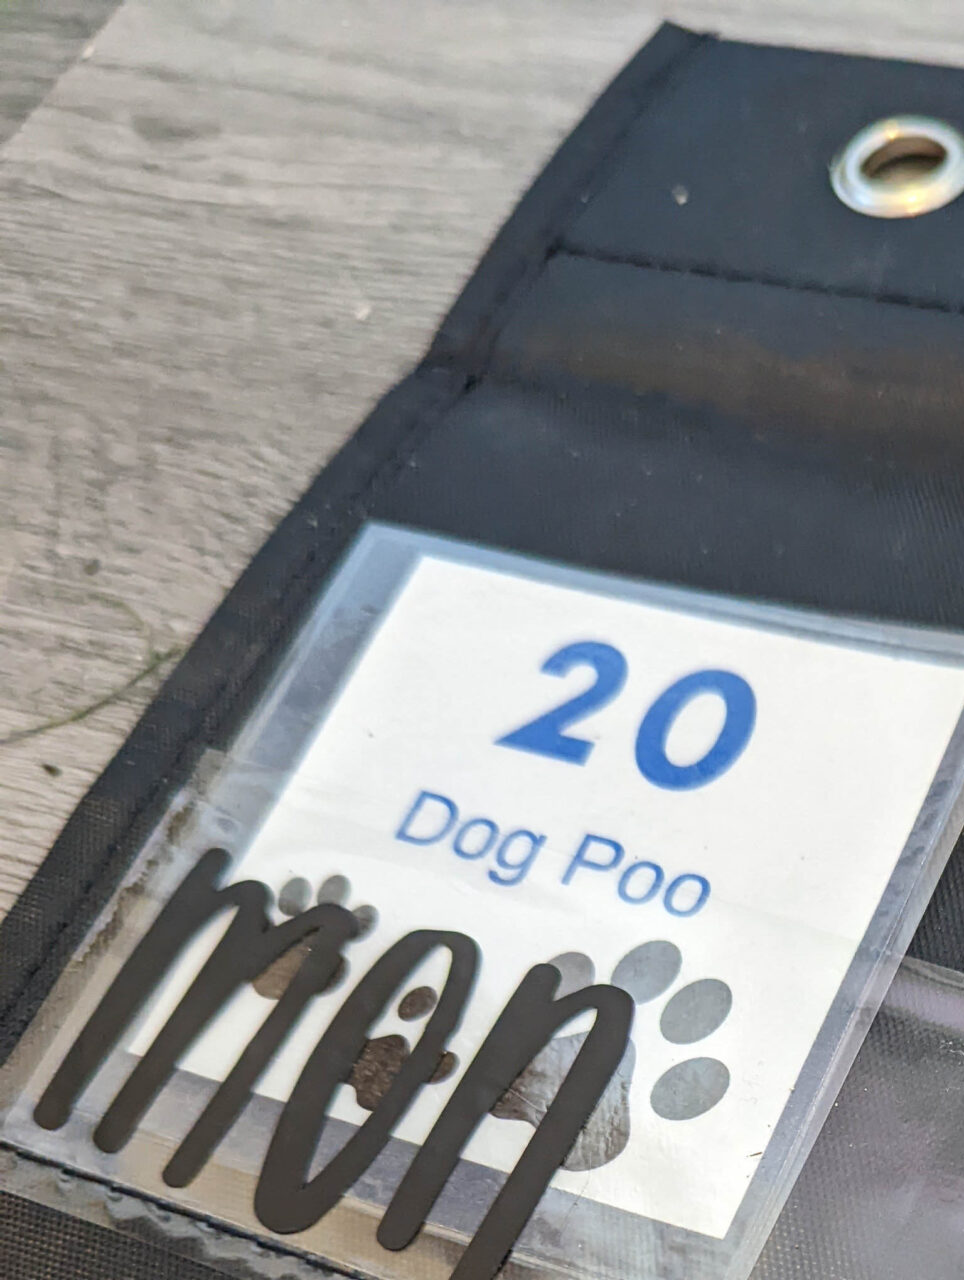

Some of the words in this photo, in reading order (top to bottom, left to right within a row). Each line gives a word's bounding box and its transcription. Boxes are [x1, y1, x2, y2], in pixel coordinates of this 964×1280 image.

[494, 640, 758, 792] 20
[395, 789, 546, 887] Dog
[561, 834, 712, 918] Poo
